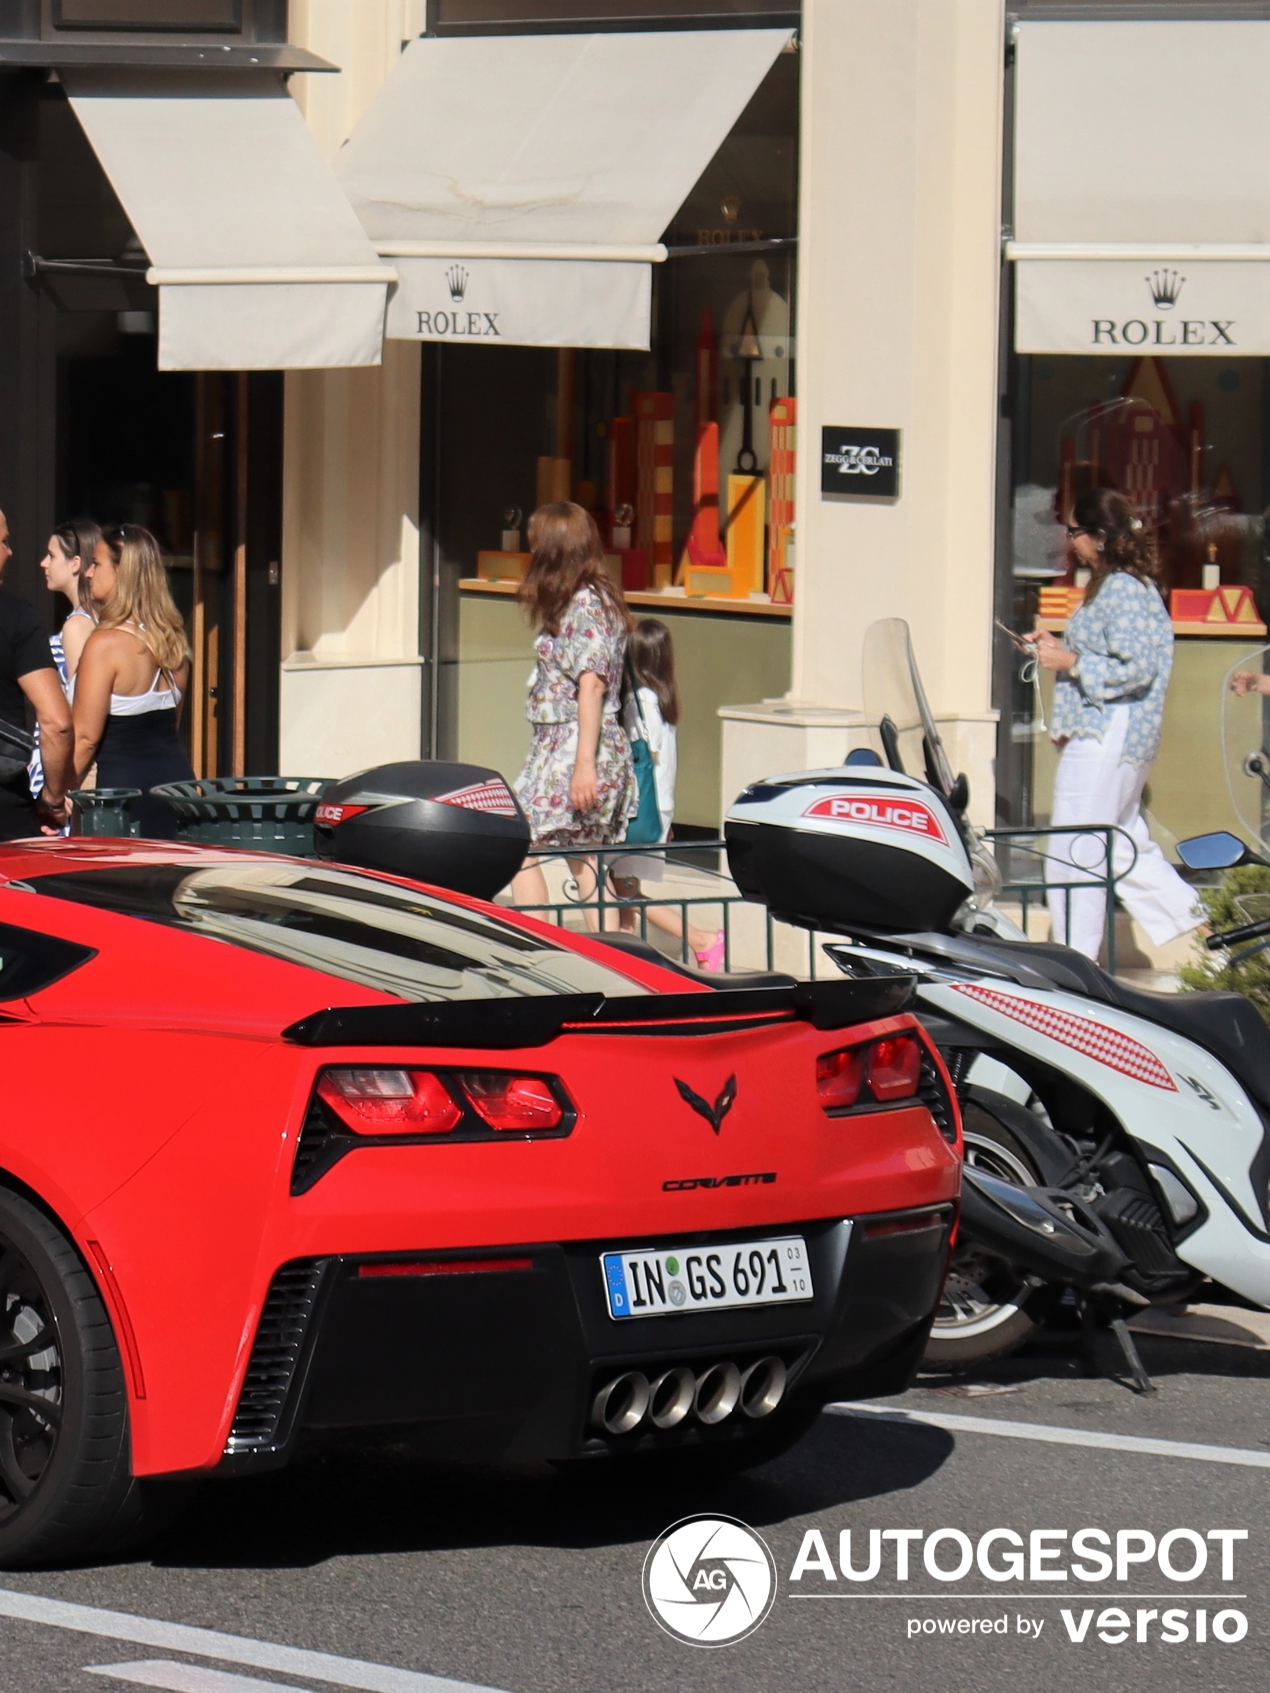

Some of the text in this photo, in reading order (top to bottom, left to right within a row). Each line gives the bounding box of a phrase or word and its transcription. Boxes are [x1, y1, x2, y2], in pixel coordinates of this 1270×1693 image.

[416, 311, 501, 336] ROLEX
[1091, 319, 1237, 345] ROLEX
[831, 800, 929, 830] POLICE
[662, 1172, 777, 1192] CORVETTE
[787, 1247, 801, 1260] 03
[629, 1248, 787, 1307] IN GS 691
[793, 1278, 806, 1292] 10
[614, 1293, 624, 1307] D
